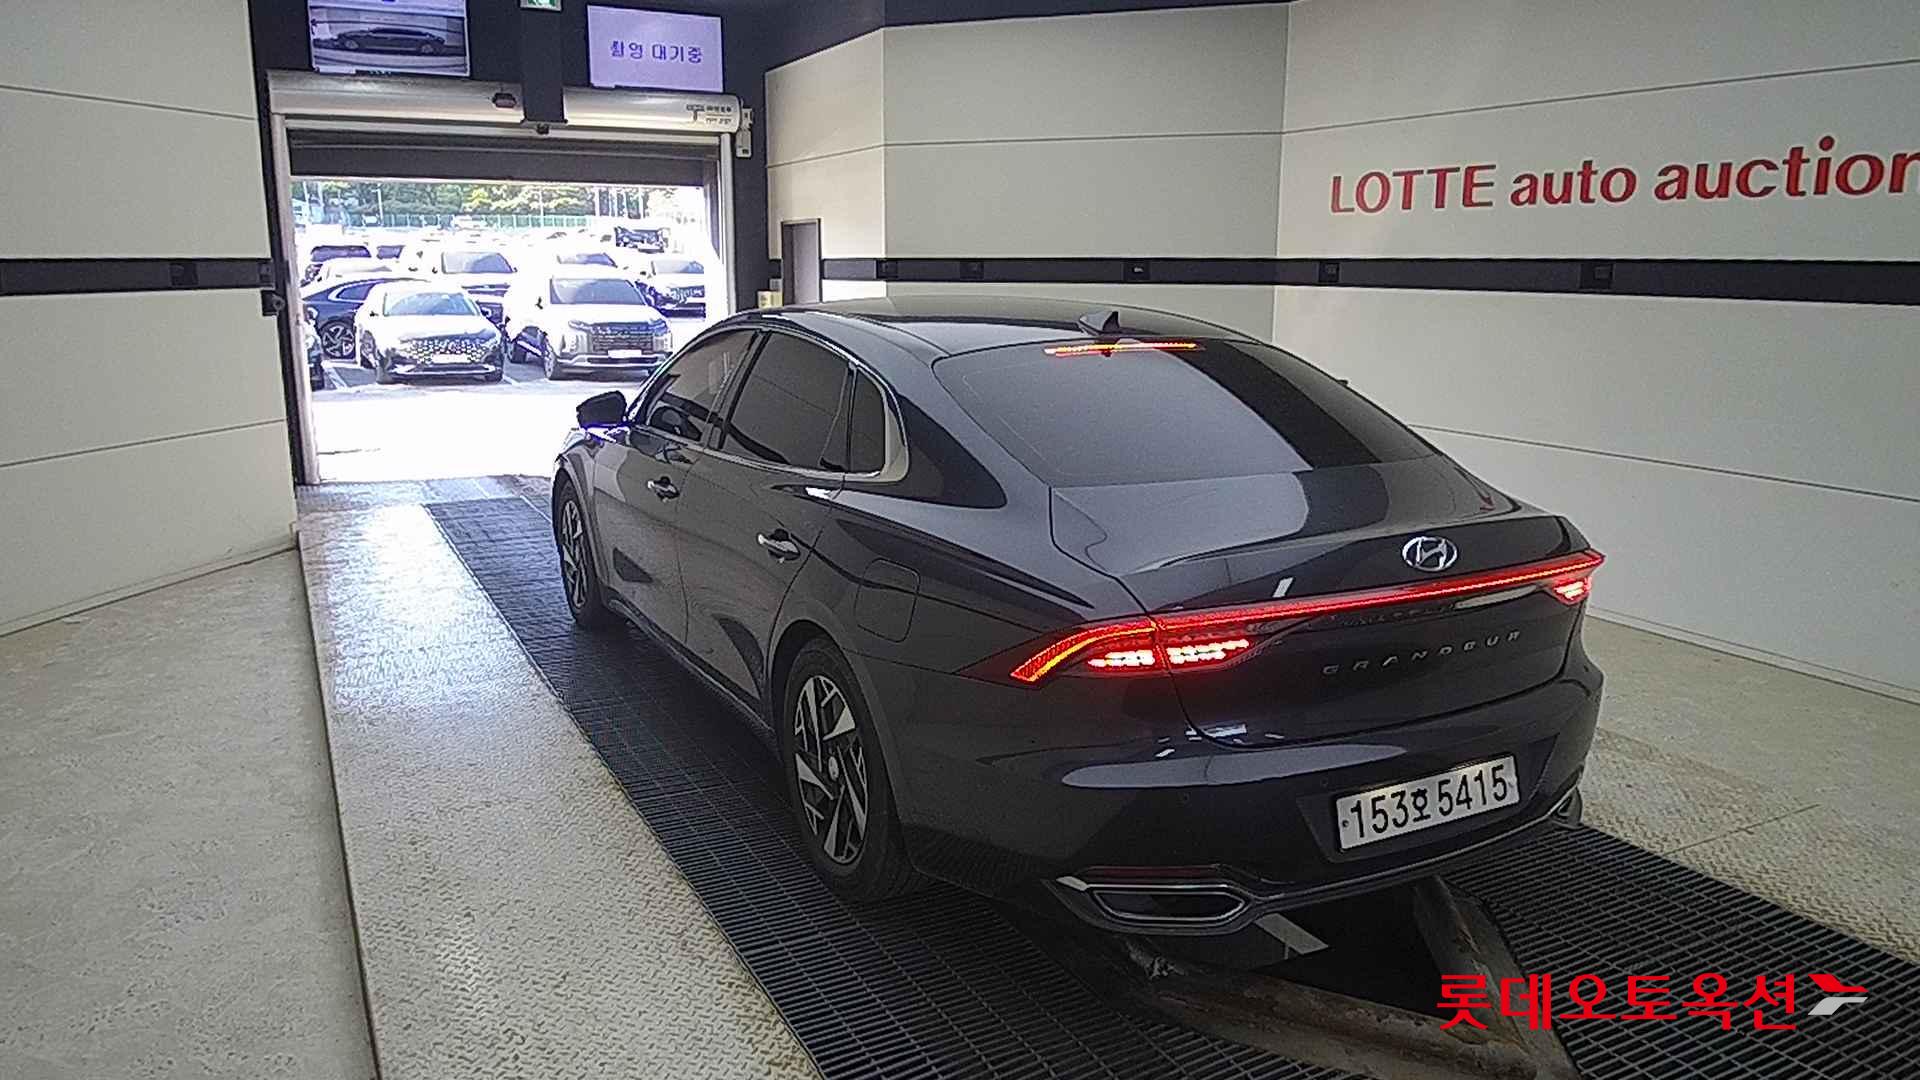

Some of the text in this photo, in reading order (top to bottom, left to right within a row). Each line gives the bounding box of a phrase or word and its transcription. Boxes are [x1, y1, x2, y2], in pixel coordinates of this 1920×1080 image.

[652, 43, 703, 64] 대기중
[1330, 135, 1920, 213] LOTTE auto auction
[1322, 629, 1521, 676] GRANDEUR
[1437, 763, 1508, 817] 5415
